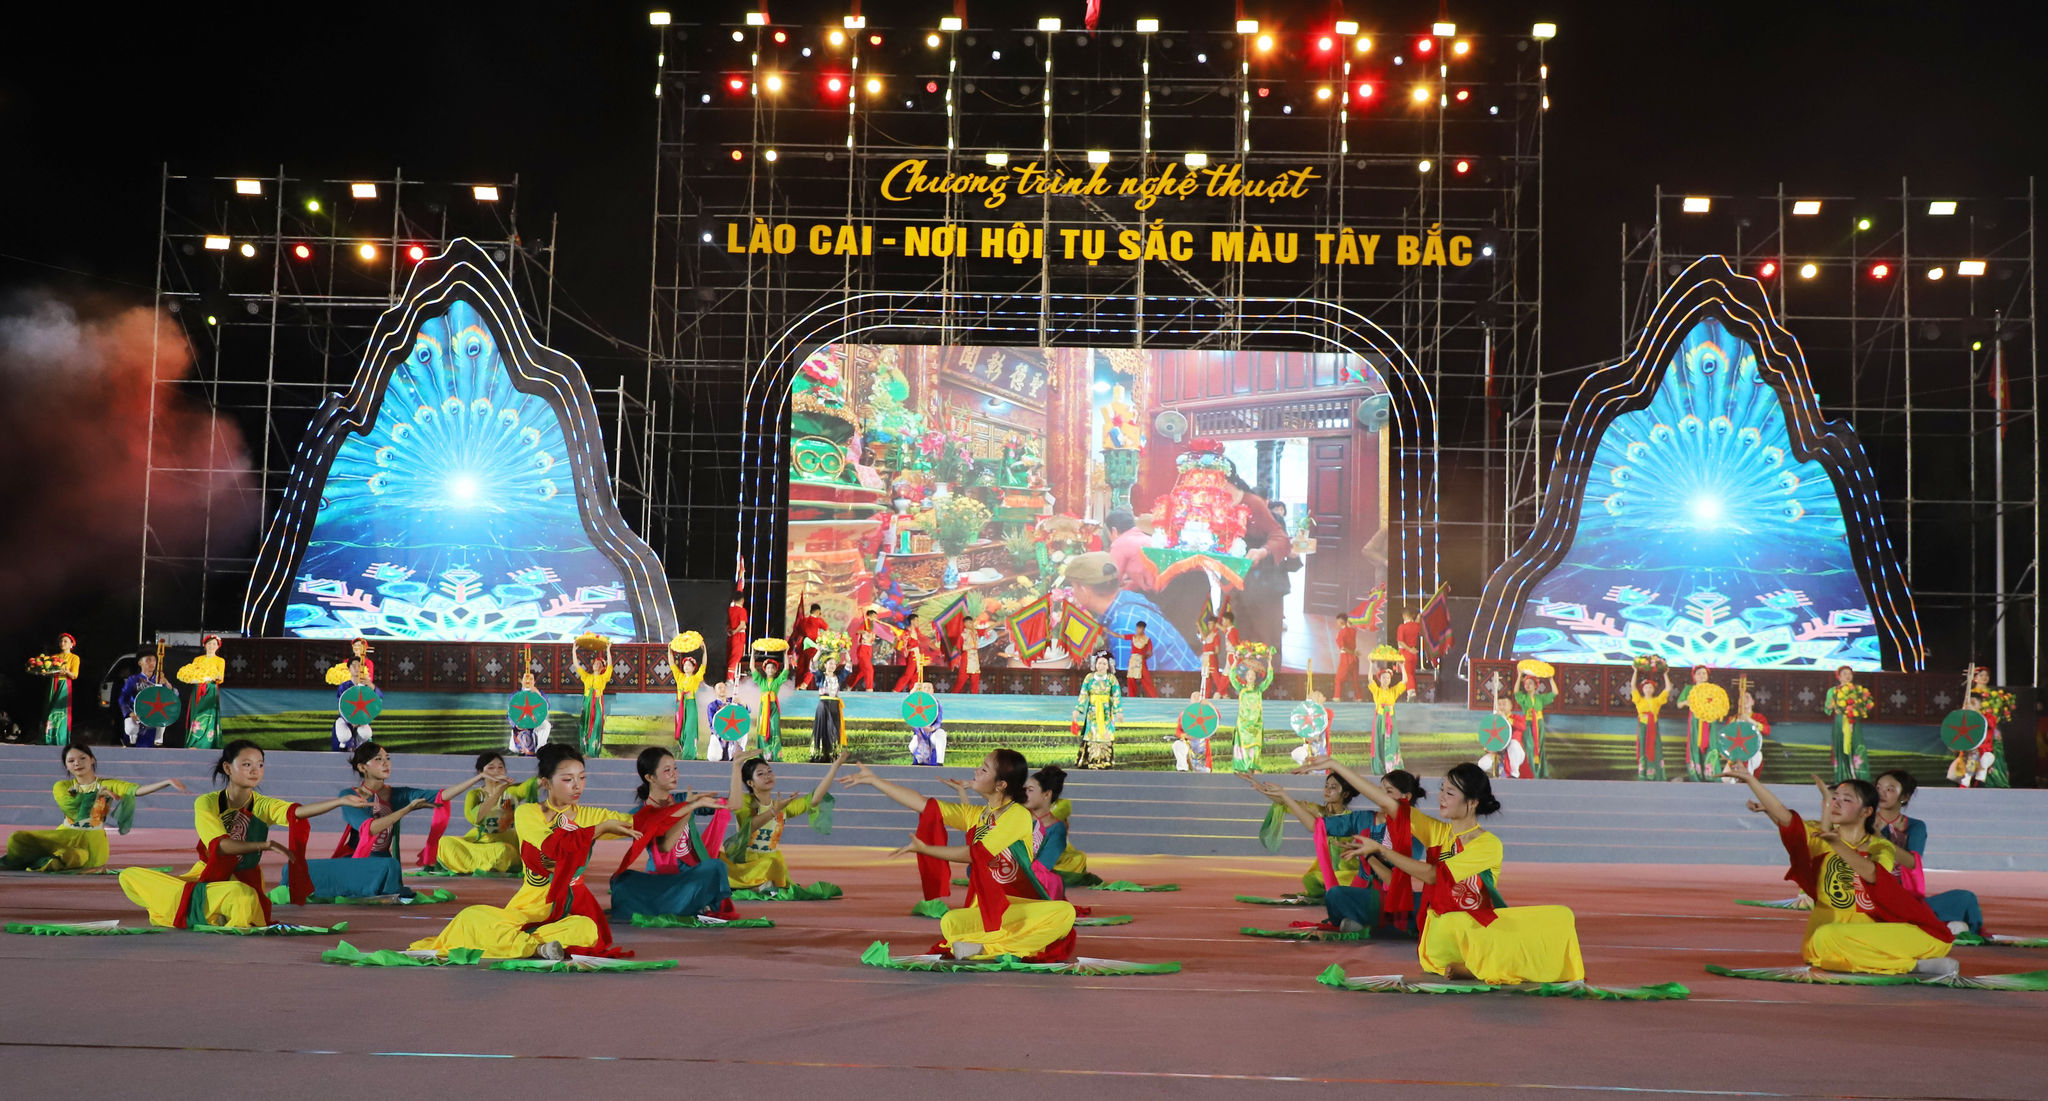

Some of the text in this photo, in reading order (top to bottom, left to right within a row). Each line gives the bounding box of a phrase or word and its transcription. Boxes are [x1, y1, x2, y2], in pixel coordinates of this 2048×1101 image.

[881, 159, 1322, 211] Chương trình nghệ thuật
[728, 218, 1473, 267] LÀO CAI - NƠI HỘI TỤ SẮC MÀU TÂY BẮC
